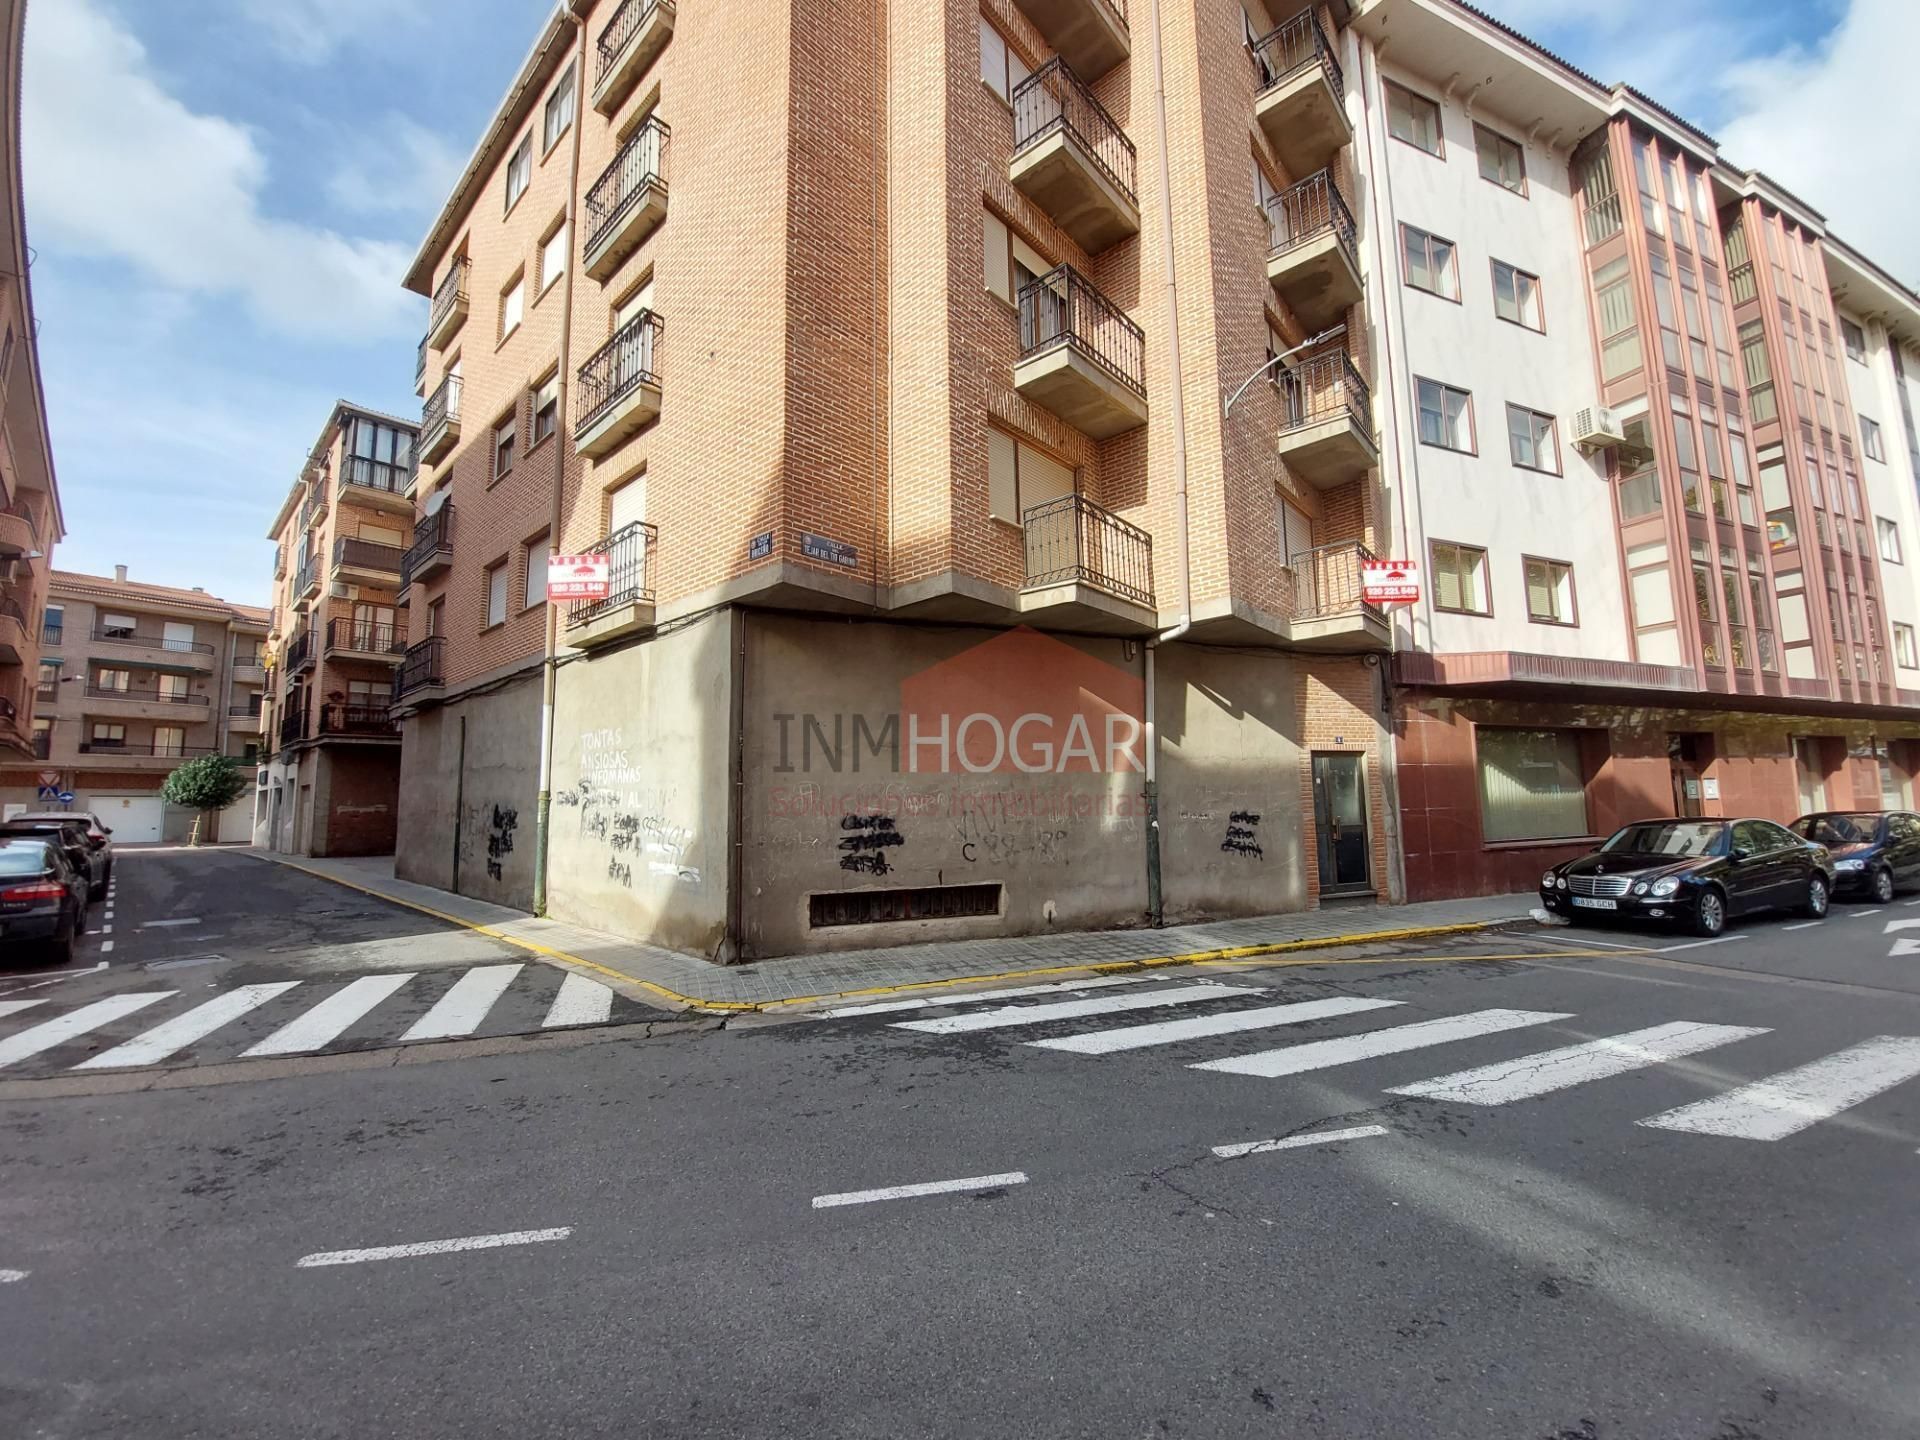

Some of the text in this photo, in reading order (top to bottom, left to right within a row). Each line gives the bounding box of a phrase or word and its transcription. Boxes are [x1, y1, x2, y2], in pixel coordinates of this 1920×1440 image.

[826, 541, 843, 550] CALLE
[804, 545, 820, 557] TEJAR
[820, 549, 830, 560] DEL
[1365, 562, 1415, 570] VENDE
[580, 727, 622, 749] TONTAS
